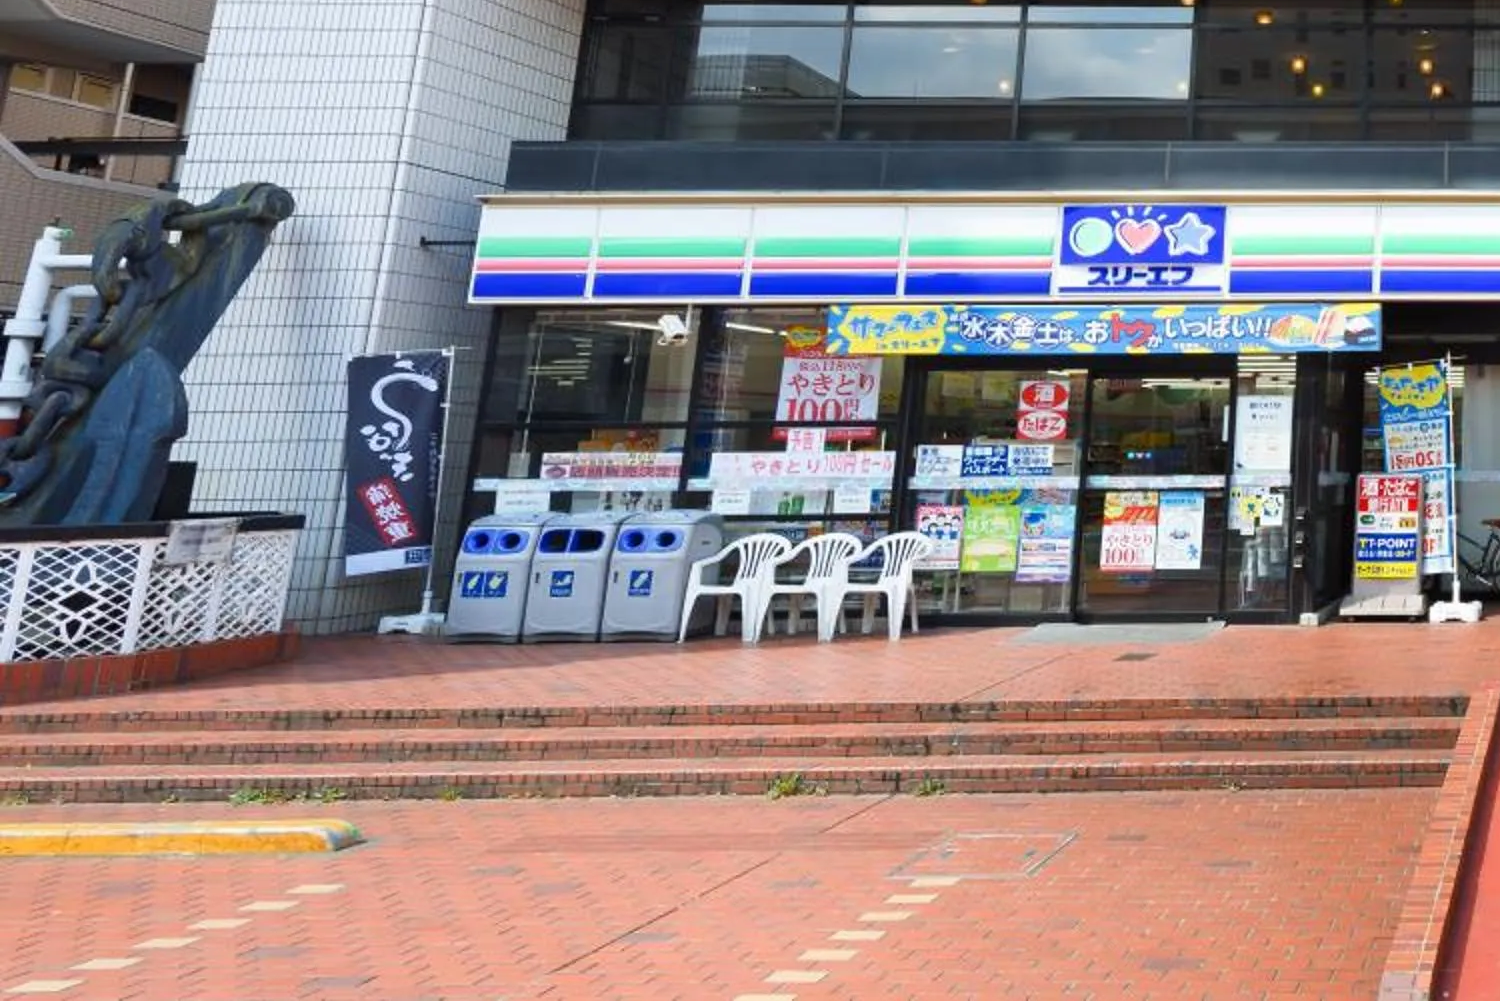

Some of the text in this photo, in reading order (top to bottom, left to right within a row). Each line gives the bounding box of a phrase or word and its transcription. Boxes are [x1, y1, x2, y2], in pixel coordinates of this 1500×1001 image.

[1087, 265, 1194, 286] スリーエフ
[787, 373, 876, 397] やきとり
[1022, 416, 1061, 433] たばこ
